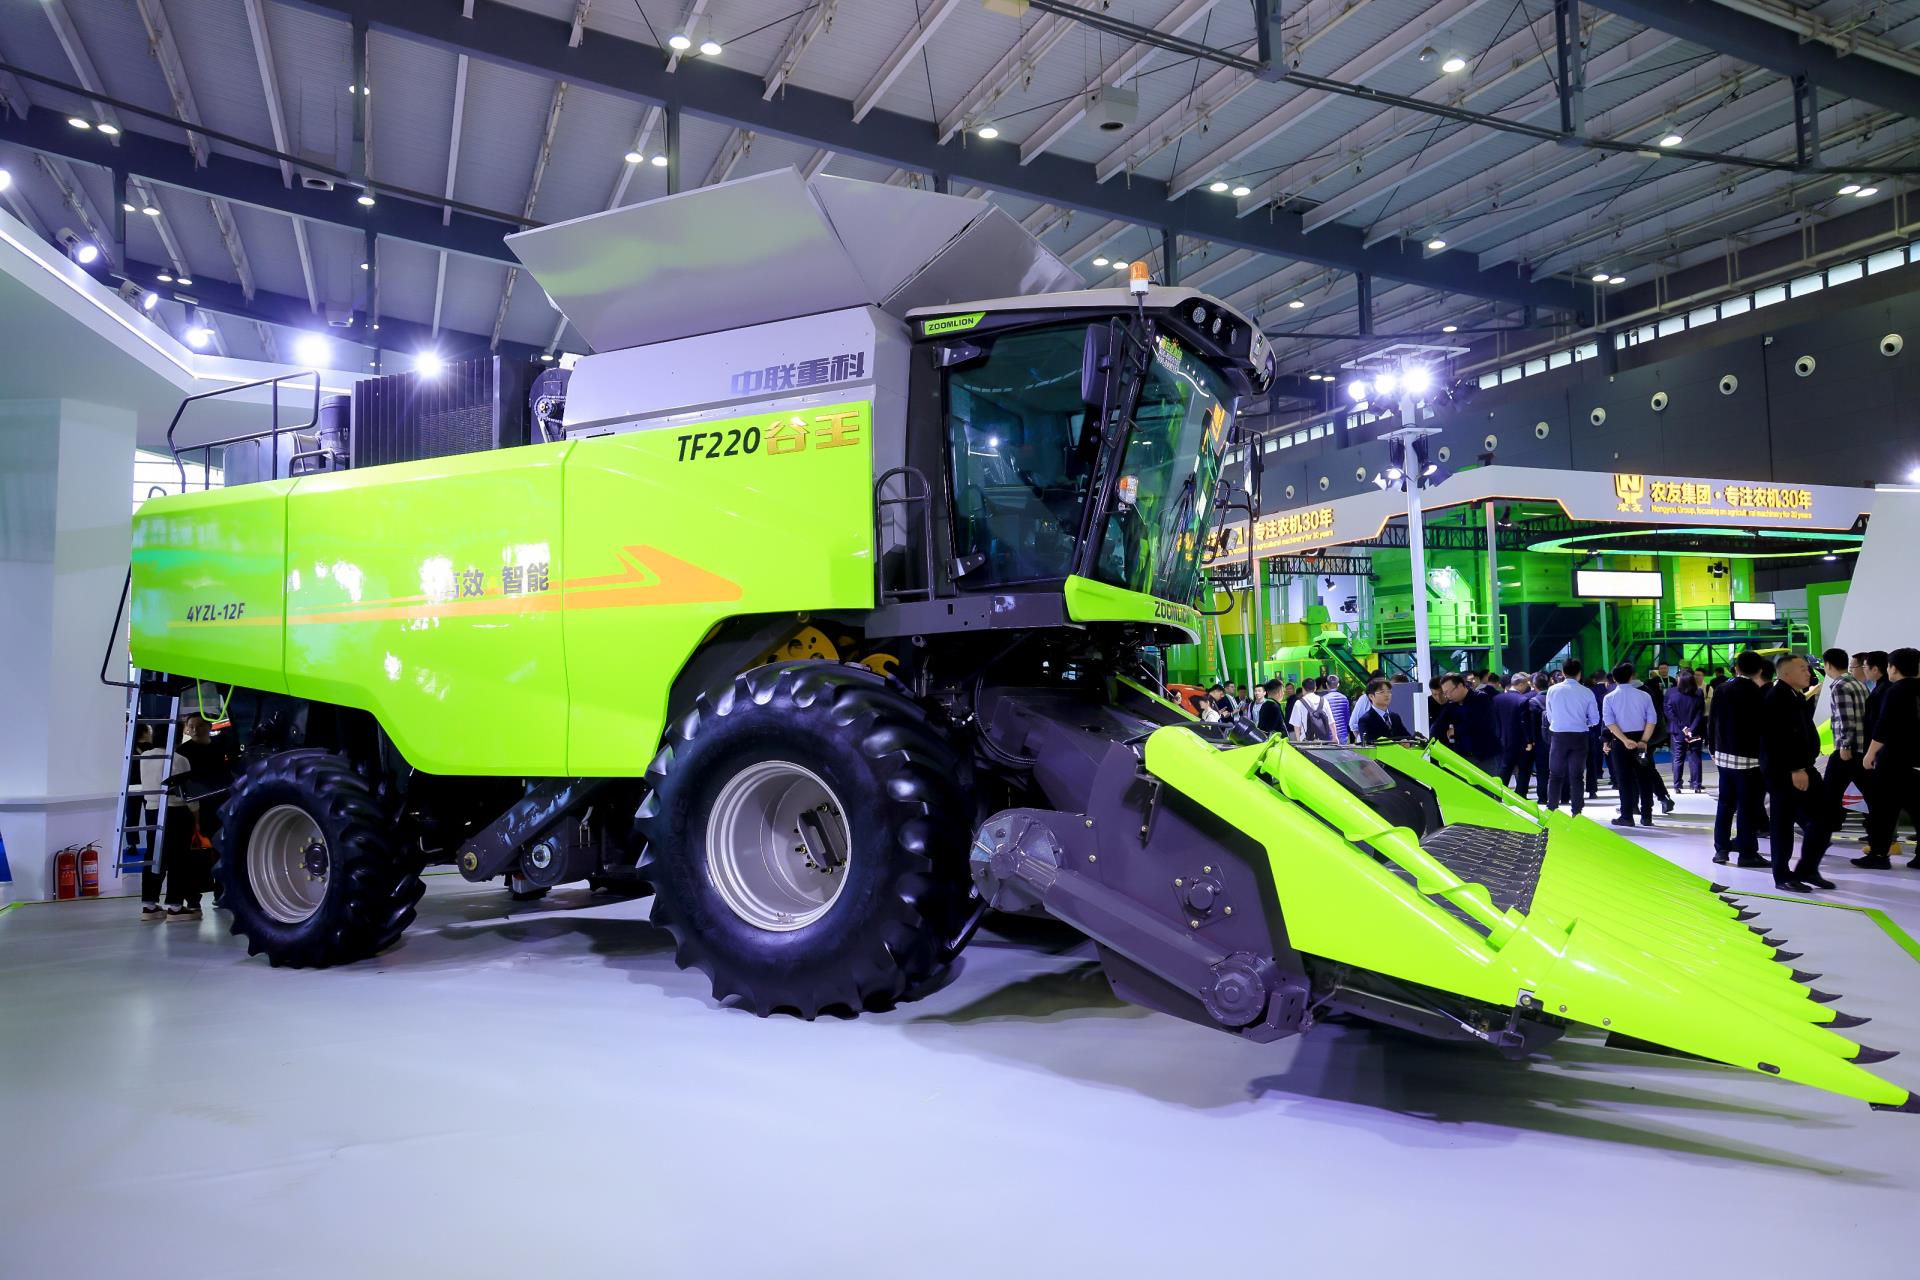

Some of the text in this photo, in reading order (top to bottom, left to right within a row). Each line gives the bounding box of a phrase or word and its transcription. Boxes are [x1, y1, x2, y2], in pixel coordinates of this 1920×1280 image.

[928, 318, 974, 331] ZOOMLION
[731, 352, 865, 395] 中联重科
[678, 426, 761, 462] TF220
[764, 410, 860, 456] 谷王
[503, 562, 549, 595] 智能
[186, 602, 245, 622] 4YZL-12F
